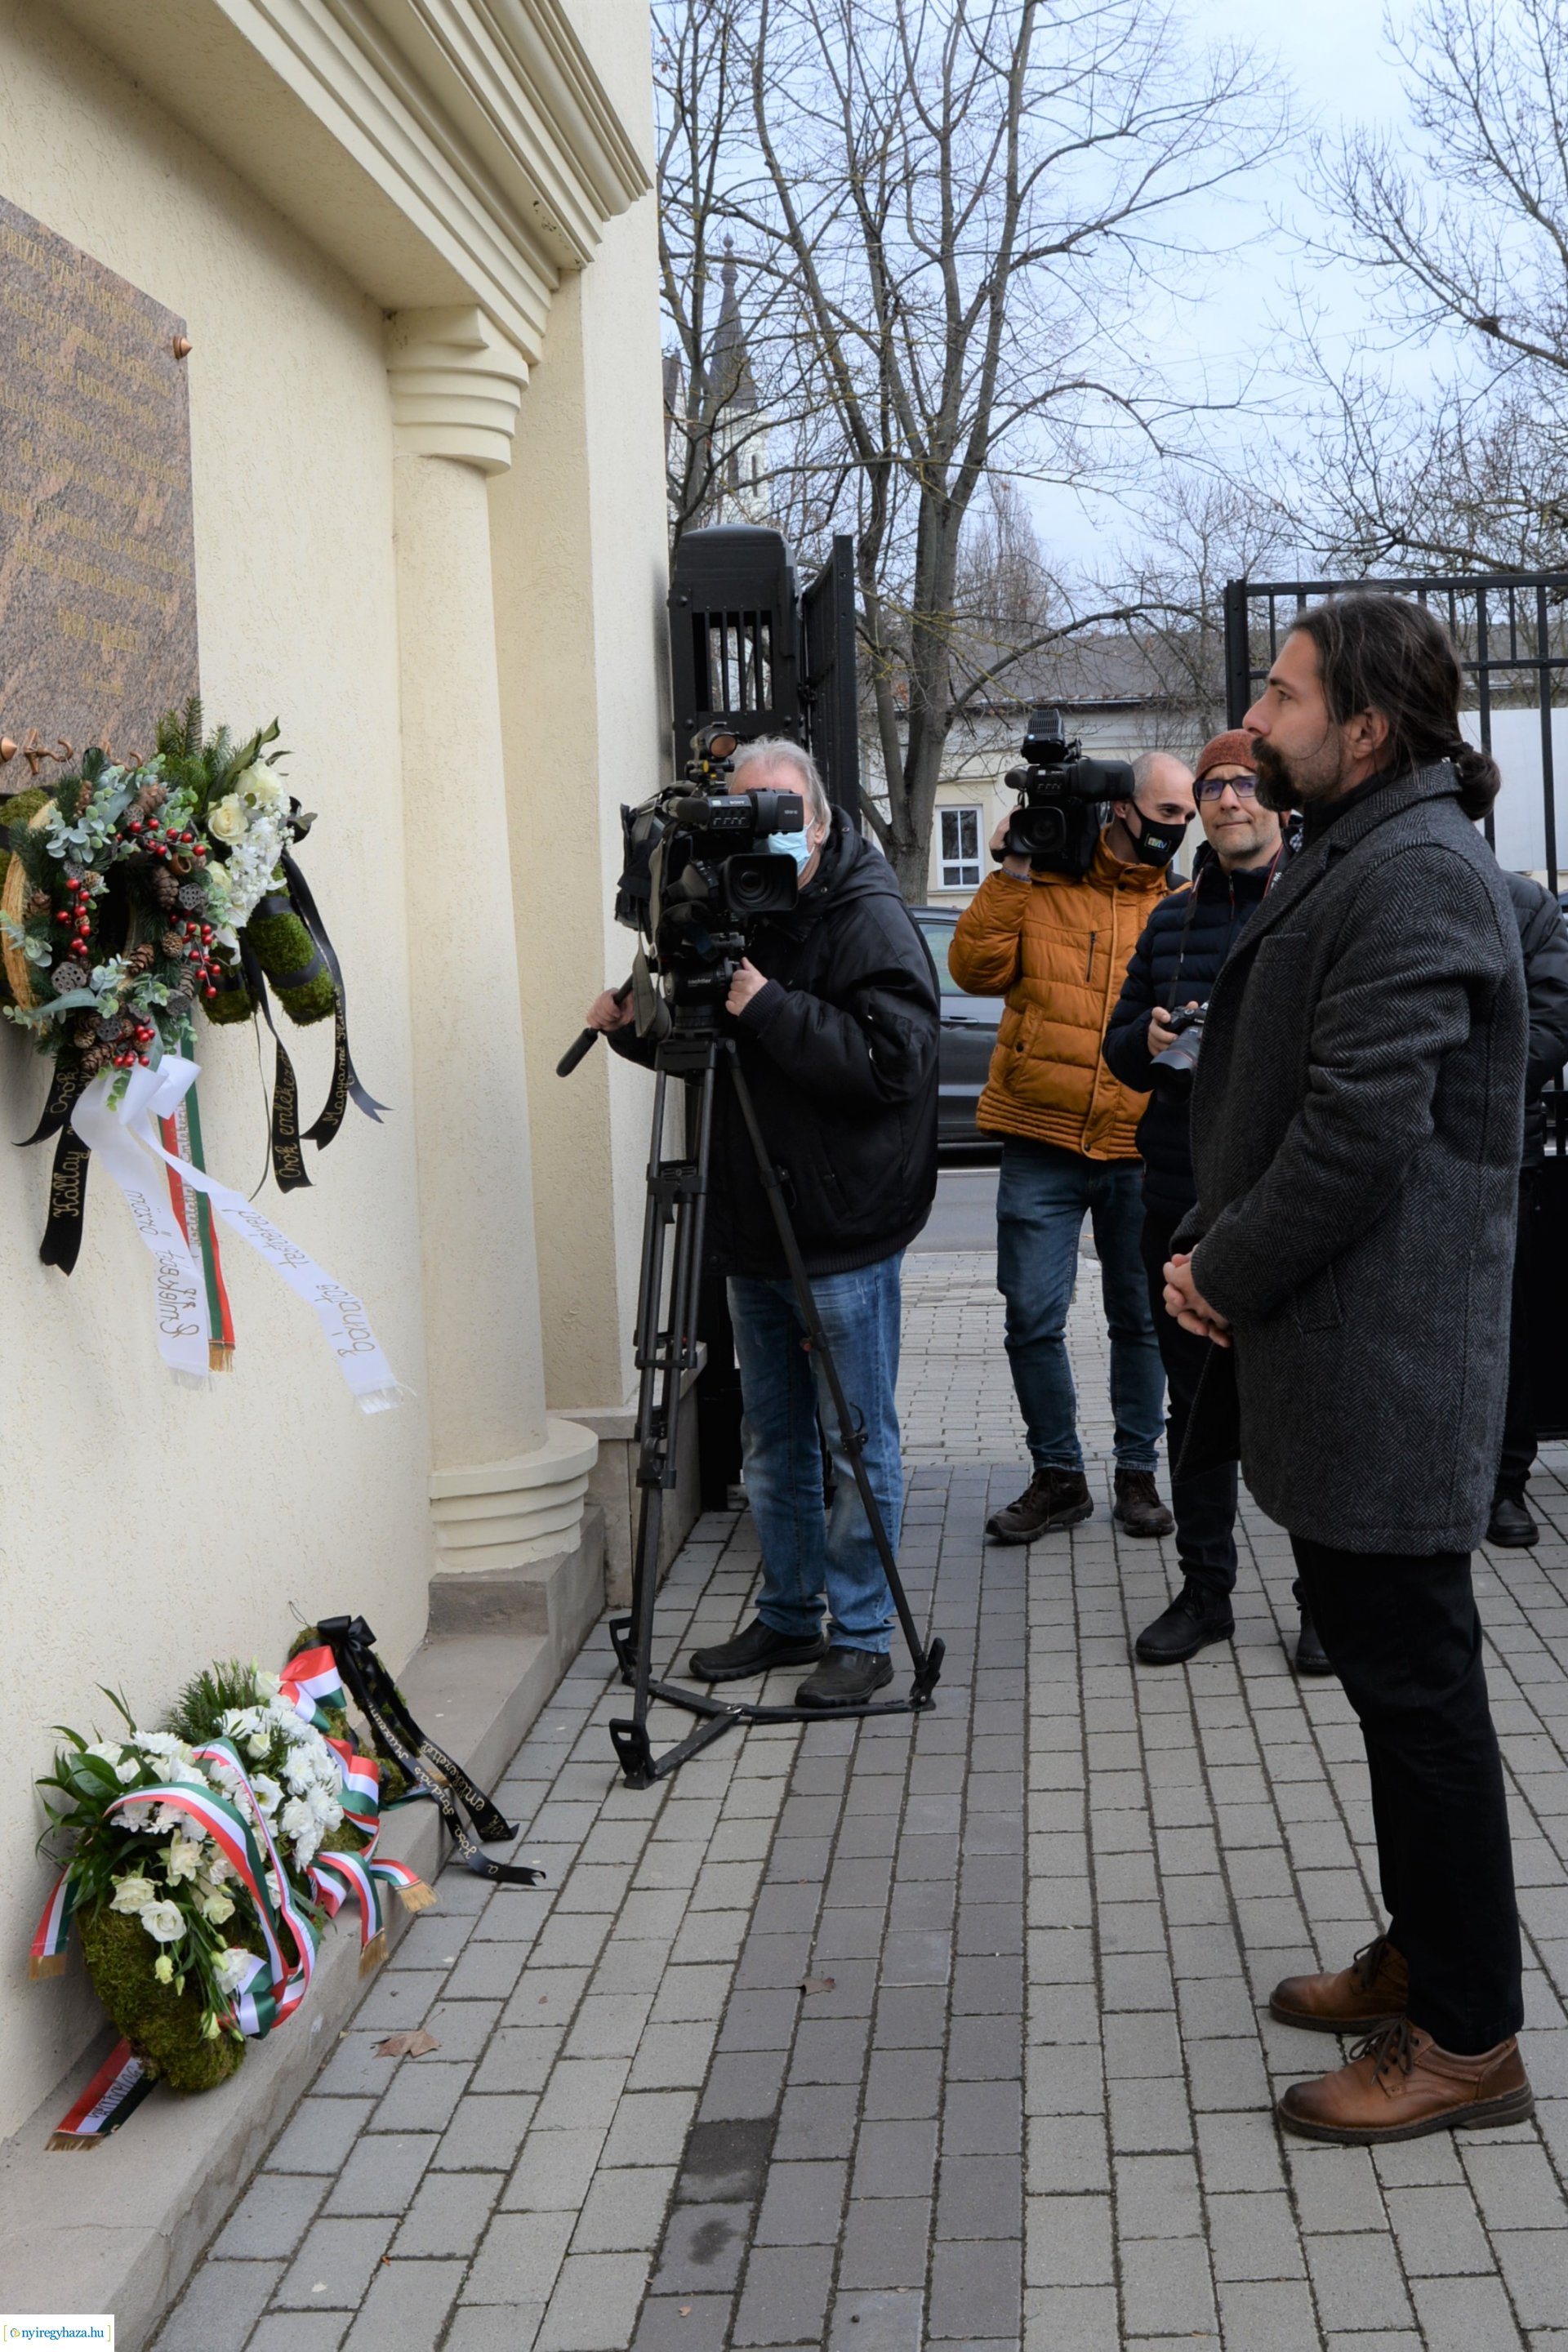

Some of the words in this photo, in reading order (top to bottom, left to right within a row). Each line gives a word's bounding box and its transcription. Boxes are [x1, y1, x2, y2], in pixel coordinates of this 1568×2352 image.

[46, 1067, 79, 1114] Örök
[52, 1149, 90, 1218] Kállay
[274, 1142, 297, 1179] Örök
